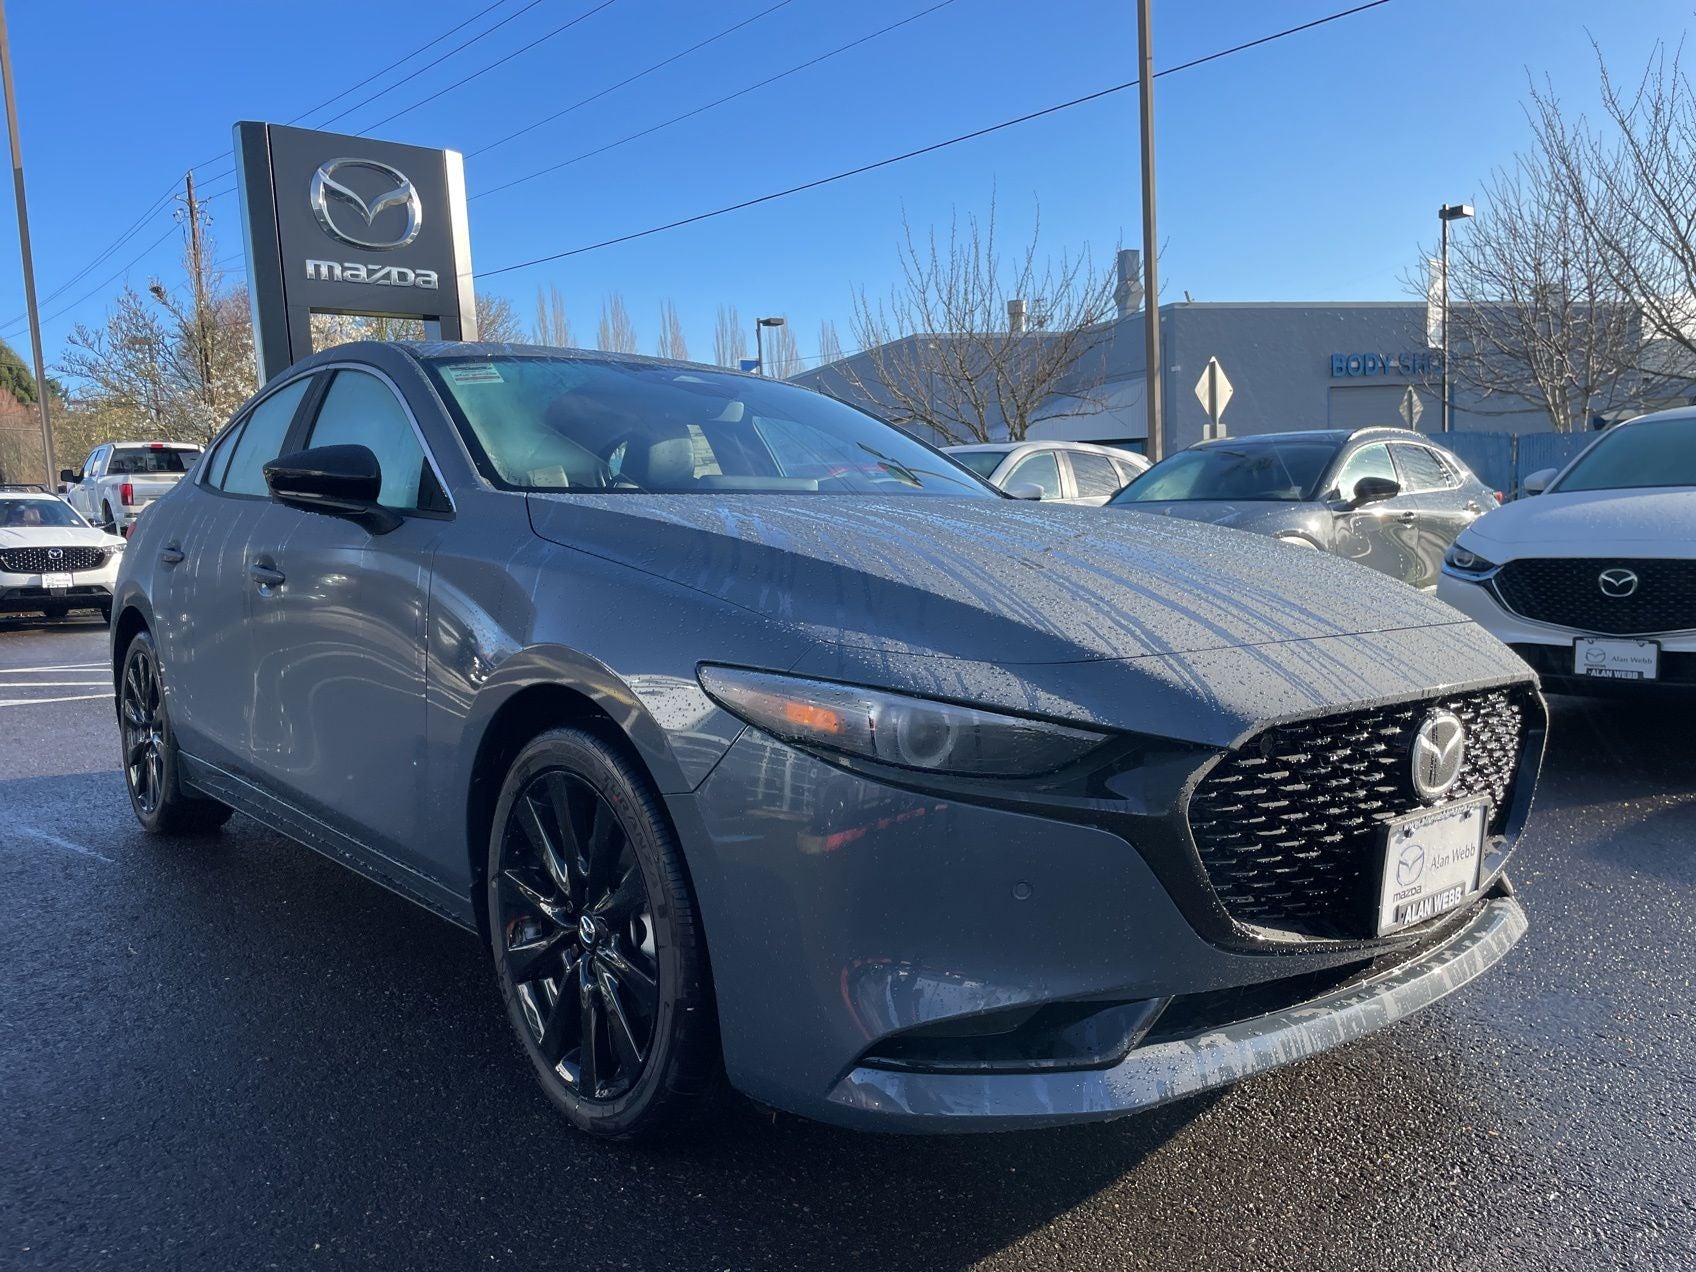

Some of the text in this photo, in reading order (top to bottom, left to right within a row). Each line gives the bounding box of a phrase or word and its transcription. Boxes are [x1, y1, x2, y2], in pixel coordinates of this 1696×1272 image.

[305, 259, 439, 290] mazda
[1331, 352, 1457, 377] BODY SHO
[1590, 669, 1639, 679] ALAN WEBB
[1430, 842, 1476, 870] Alan Webb
[1393, 885, 1422, 903] mazda
[1402, 886, 1462, 925] ALAN WEBB
